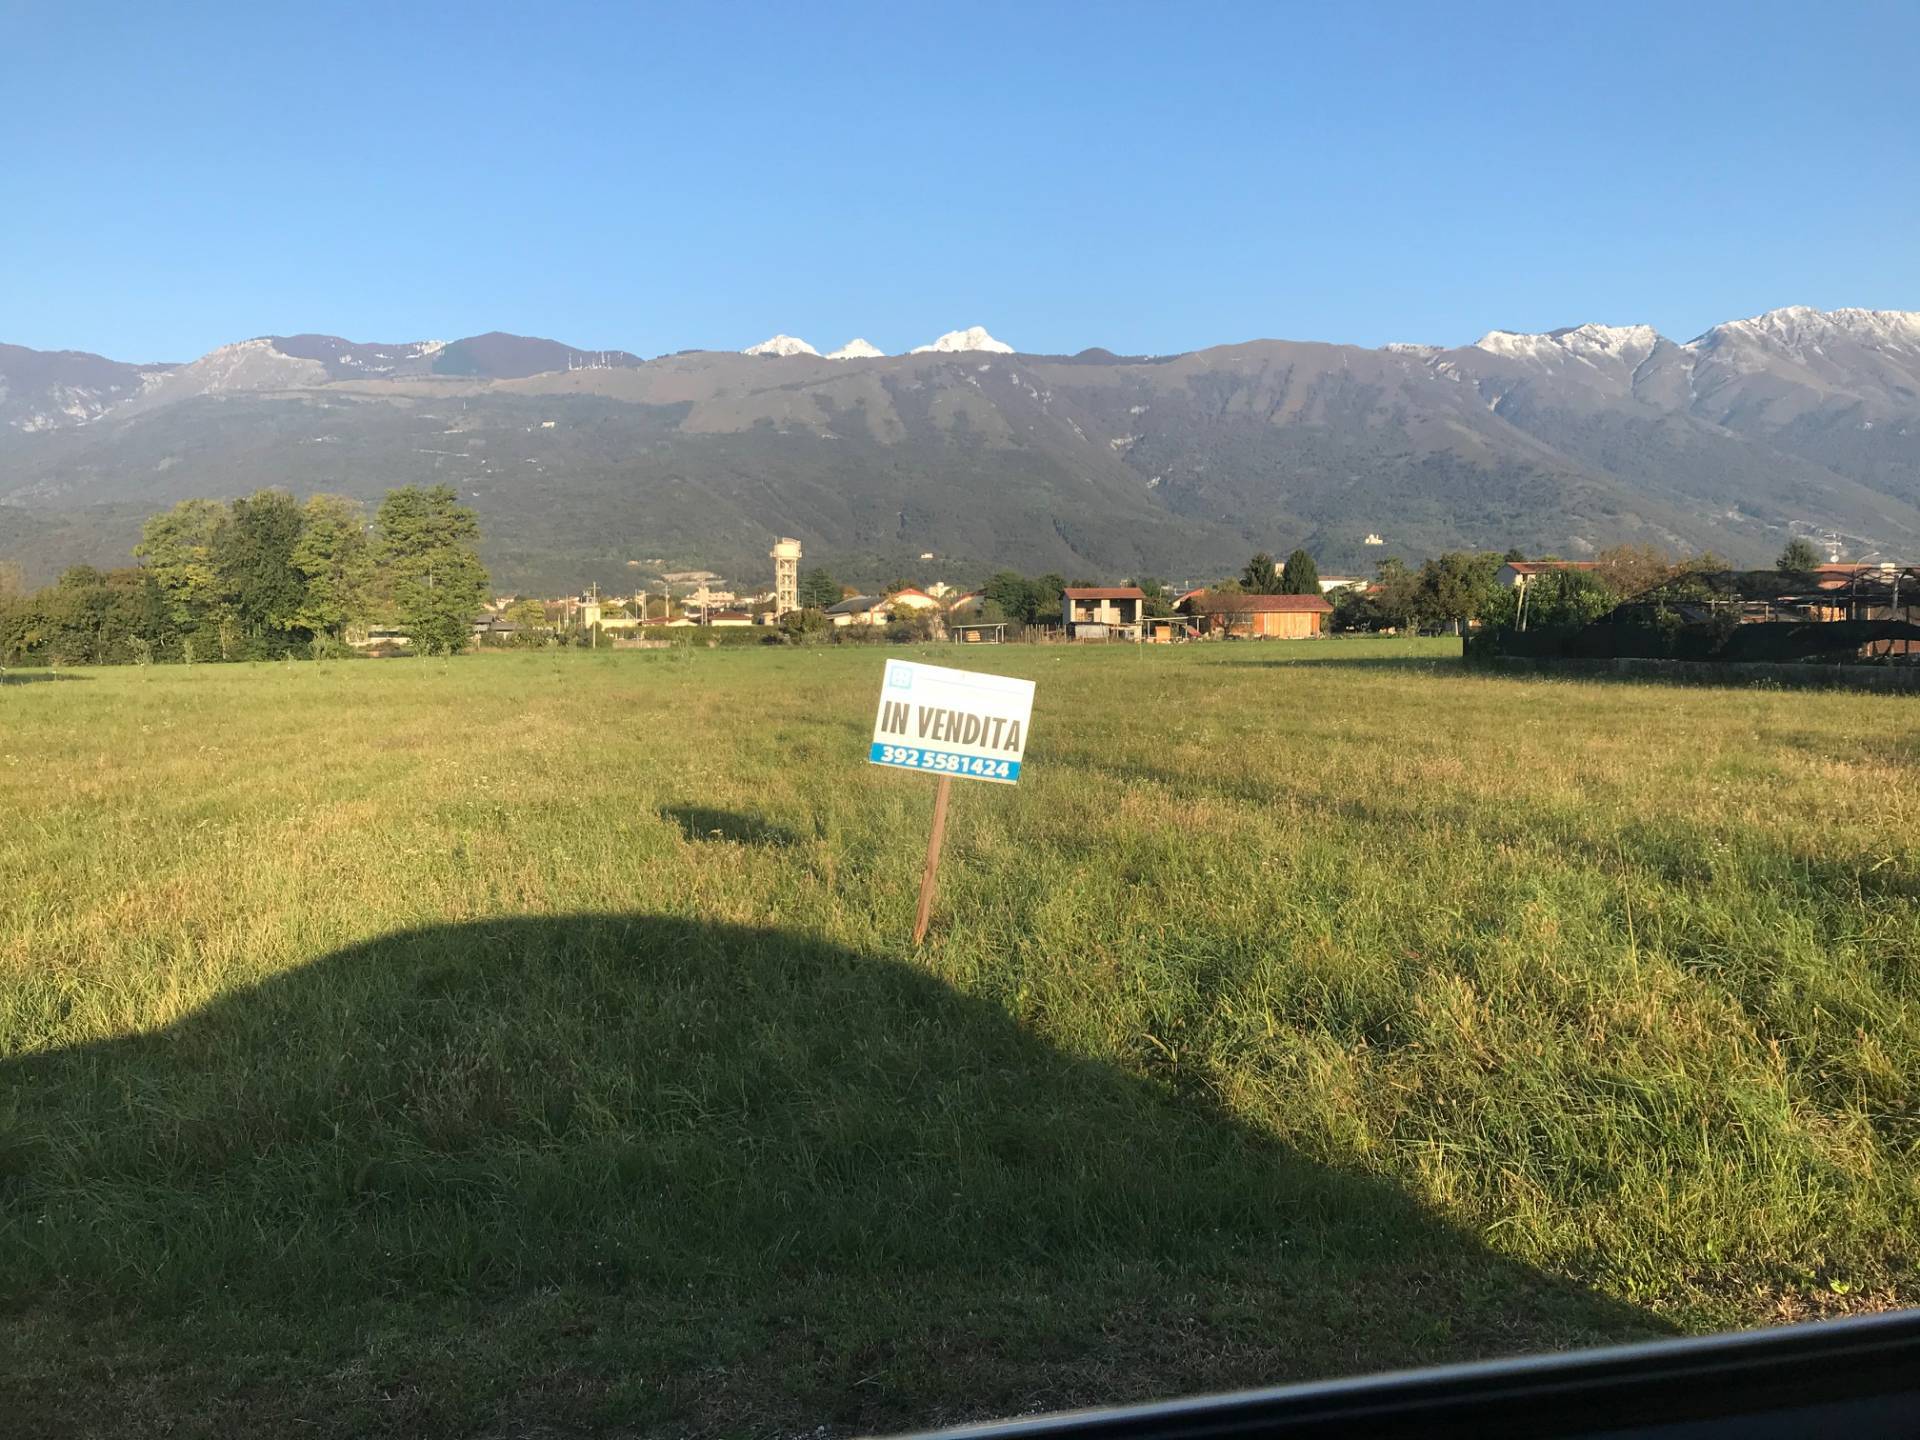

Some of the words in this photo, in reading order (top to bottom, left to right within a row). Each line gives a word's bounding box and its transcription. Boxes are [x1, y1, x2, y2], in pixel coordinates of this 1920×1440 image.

[881, 701, 910, 735] IN
[918, 705, 1021, 752] VENDITA
[881, 746, 918, 766] 392
[922, 752, 1009, 777] 5581424
